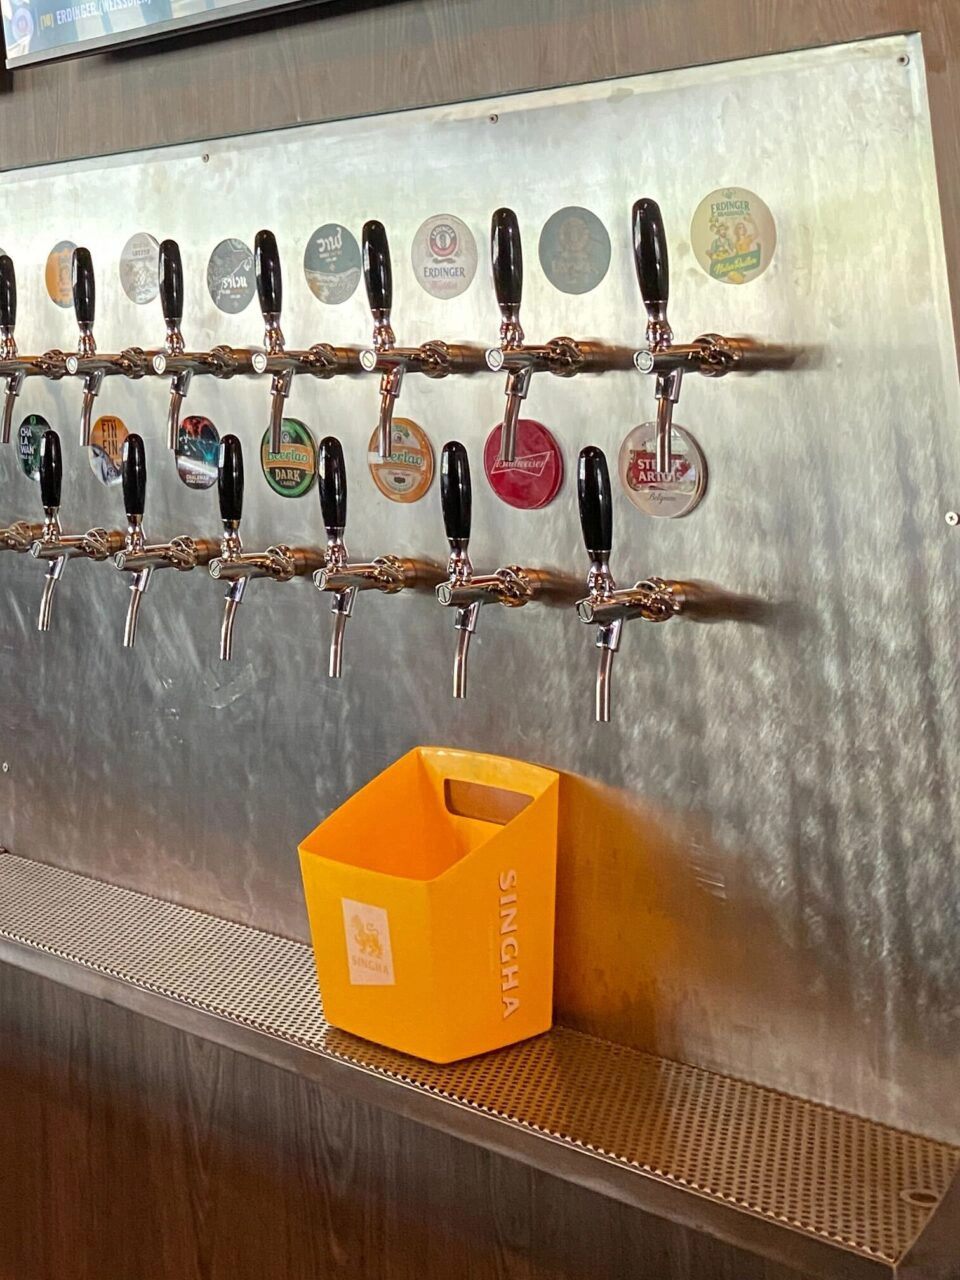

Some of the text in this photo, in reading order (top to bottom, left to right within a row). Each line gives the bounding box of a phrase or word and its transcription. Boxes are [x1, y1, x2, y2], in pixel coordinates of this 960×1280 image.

[56, 1, 97, 25] ERDINGER
[711, 200, 750, 217] ERDINGER
[424, 266, 466, 278] ERDINGER
[20, 427, 32, 437] CHA
[101, 422, 117, 437] FIN
[20, 436, 29, 445] LA
[102, 439, 117, 455] FIN
[20, 445, 34, 454] WAN
[267, 450, 309, 464] Beerlao
[275, 470, 301, 483] DARK
[638, 471, 683, 482] ARTOIS
[498, 869, 521, 1020] SINGHA
[351, 954, 390, 975] SINGHA
